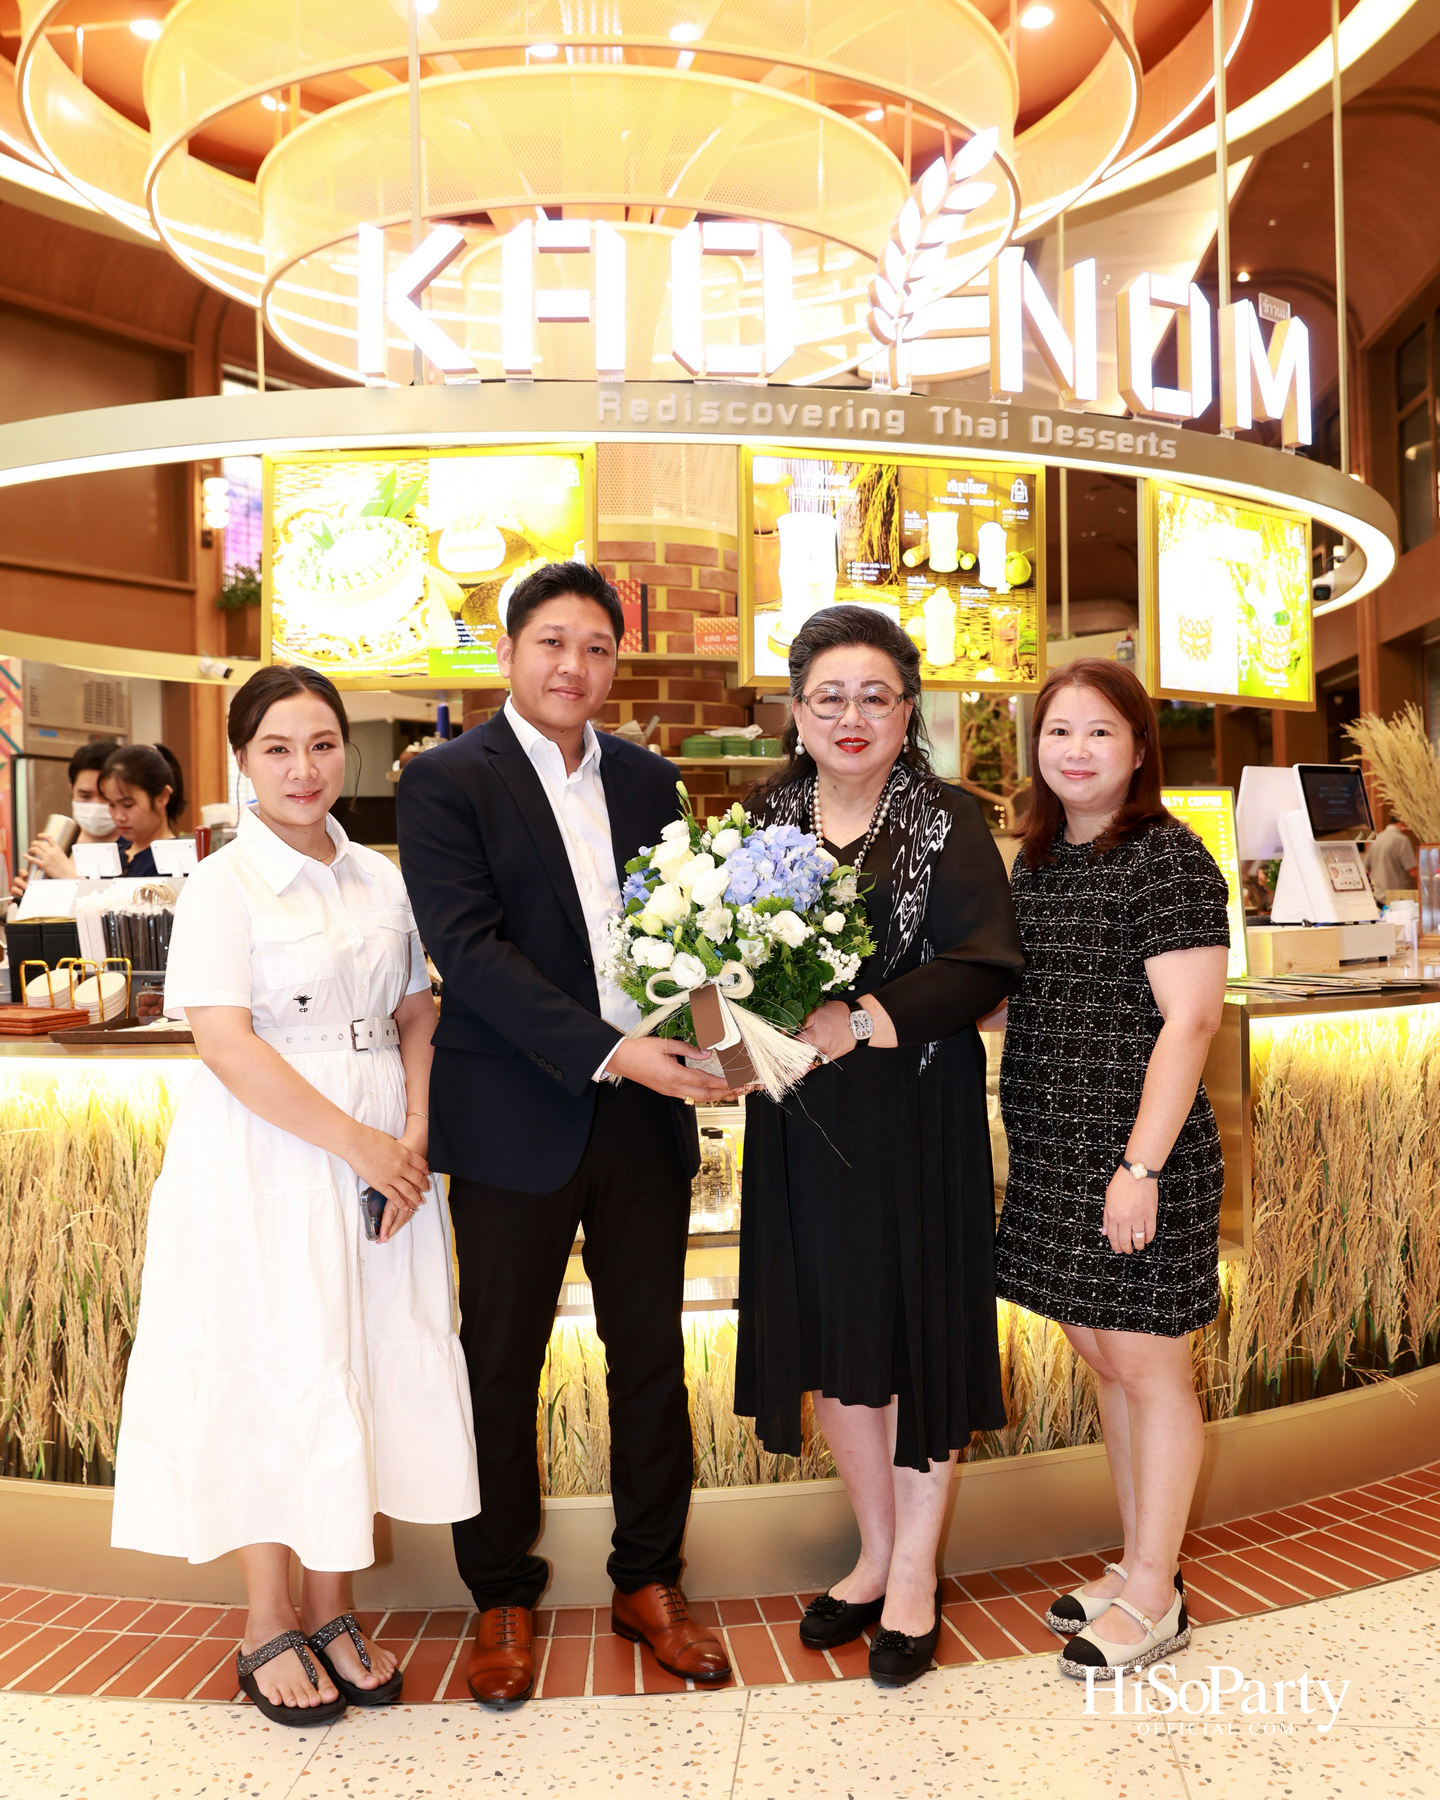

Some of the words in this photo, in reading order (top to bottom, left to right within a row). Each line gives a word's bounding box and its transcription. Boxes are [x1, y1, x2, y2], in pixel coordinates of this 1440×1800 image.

[358, 218, 796, 377] KAO
[988, 245, 1312, 449] NOM
[599, 390, 905, 435] Rediscovering
[928, 405, 1009, 440] Thai
[1031, 414, 1178, 460] Desserts
[726, 634, 738, 642] NO
[1187, 796, 1222, 807] COFFEE
